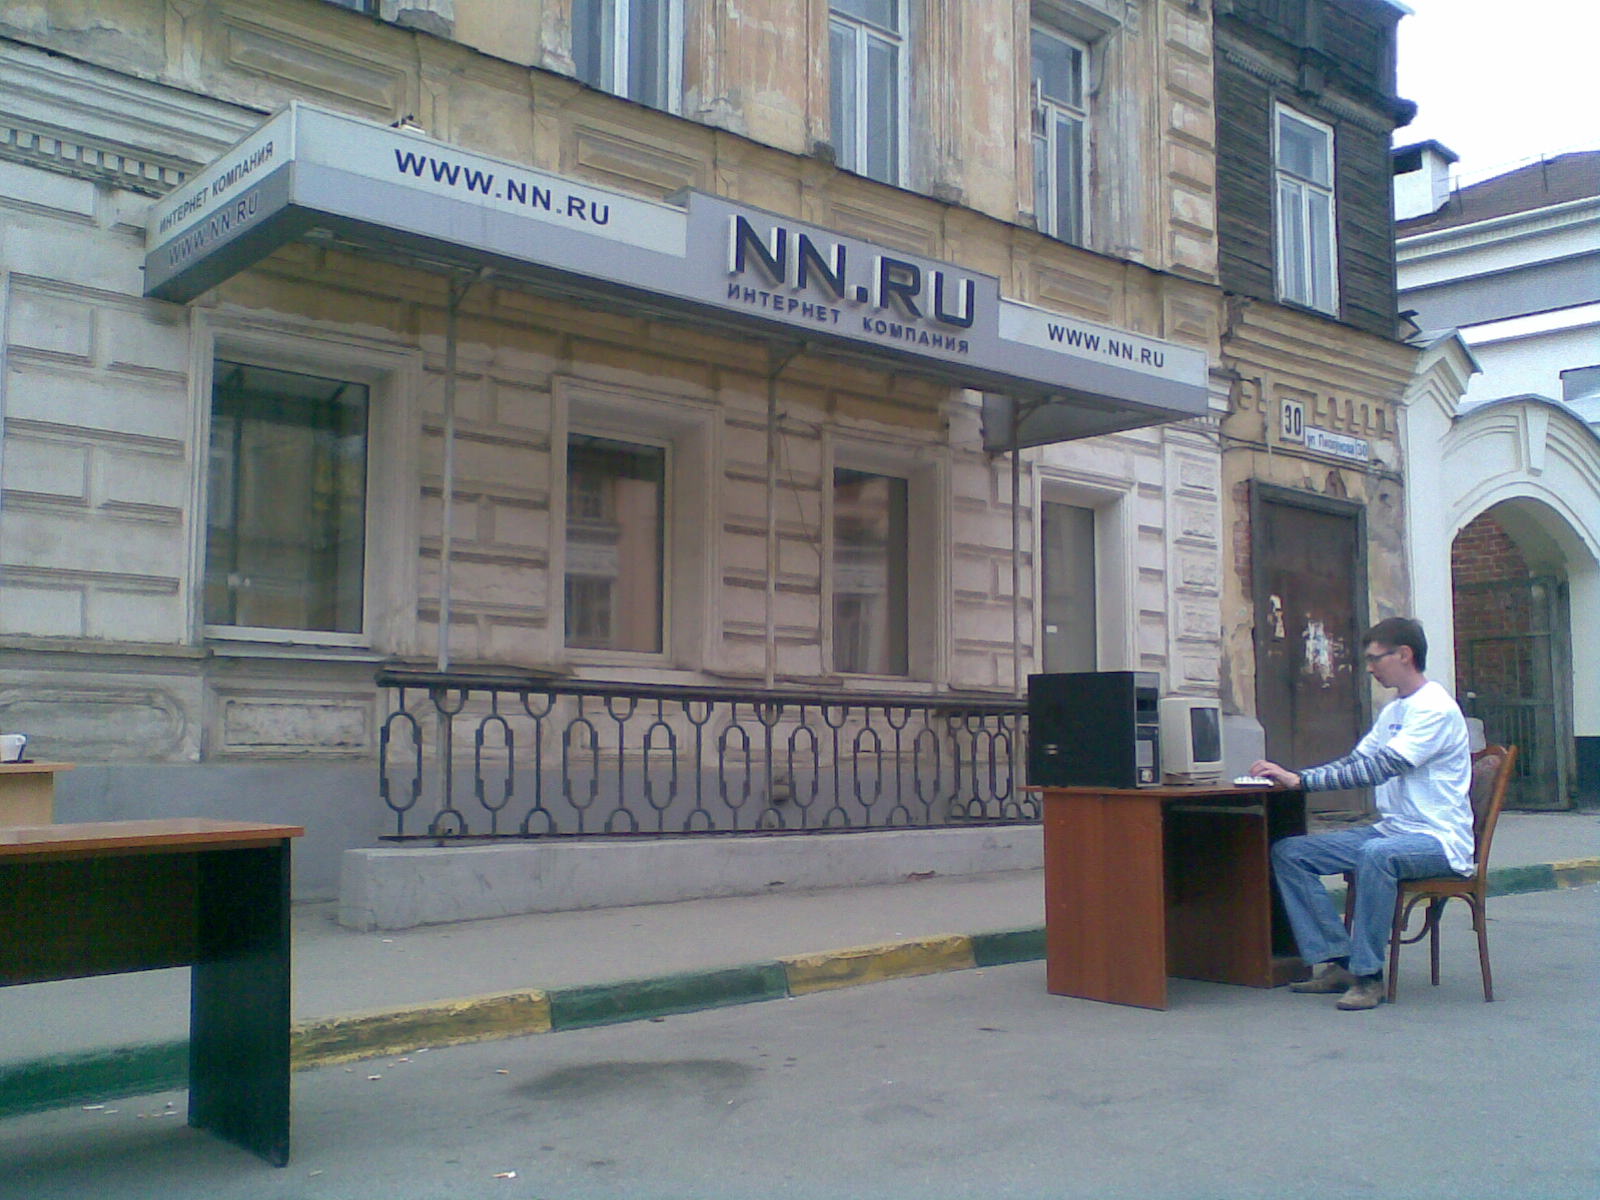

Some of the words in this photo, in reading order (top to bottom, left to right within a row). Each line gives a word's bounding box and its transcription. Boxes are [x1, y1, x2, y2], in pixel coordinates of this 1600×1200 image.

[160, 187, 209, 234] ИНТЕРНЕТ
[212, 141, 274, 196] КОМПАНИЯ
[394, 148, 610, 226] WWW.NN.RU
[728, 214, 976, 329] NN.RU
[727, 282, 841, 324] ИНТЕРНЕТ
[862, 315, 969, 354] КОМПАНИЯ
[1047, 322, 1165, 369] WWW.NN.RU
[1284, 404, 1302, 436] 30
